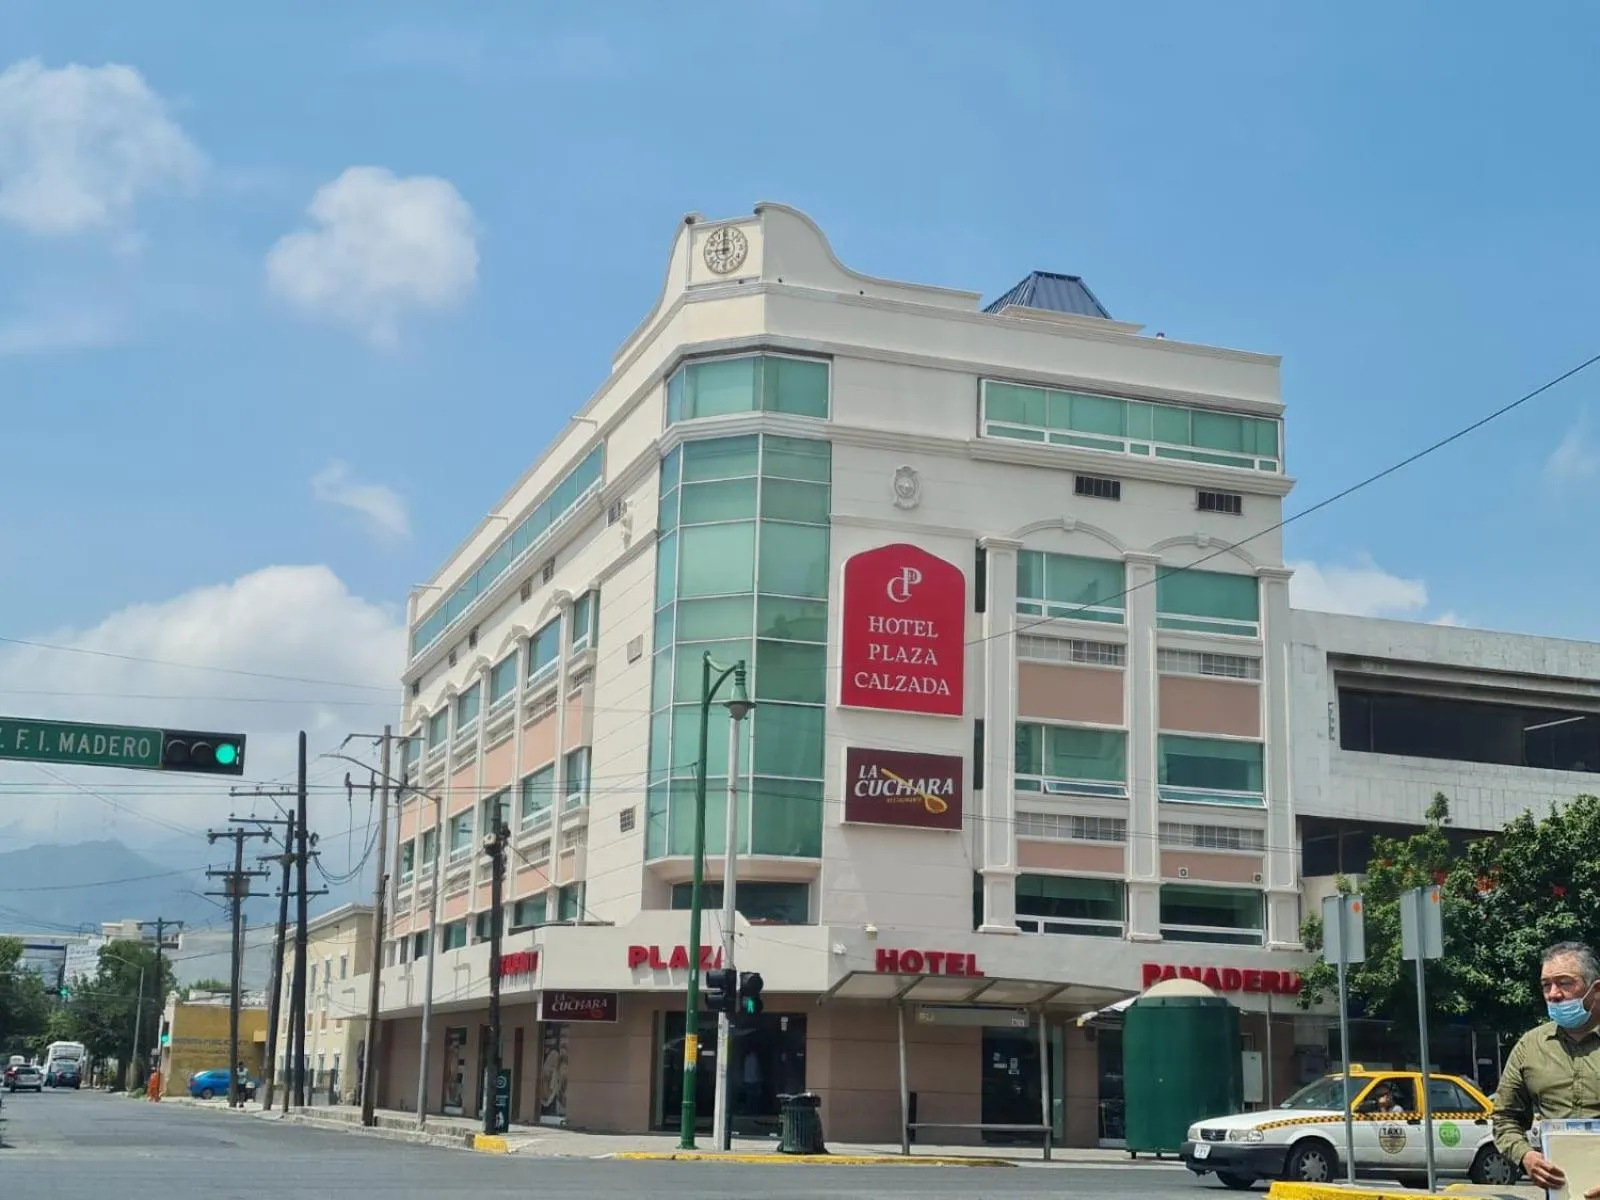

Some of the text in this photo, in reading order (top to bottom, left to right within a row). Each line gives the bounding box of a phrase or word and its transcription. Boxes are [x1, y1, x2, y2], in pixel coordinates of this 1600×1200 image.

[867, 615, 939, 638] HOTEL
[867, 643, 938, 666] PLAZA
[853, 671, 952, 696] CALZADA
[16, 728, 30, 751] F.
[38, 730, 50, 752] I.
[58, 731, 151, 759] MADERO
[859, 764, 878, 779] LA
[853, 777, 954, 798] CUCHARA
[875, 948, 985, 977] HOTEL
[550, 998, 608, 1013] CUCHARA
[554, 992, 566, 1002] LA
[1382, 1127, 1403, 1136] TAXI
